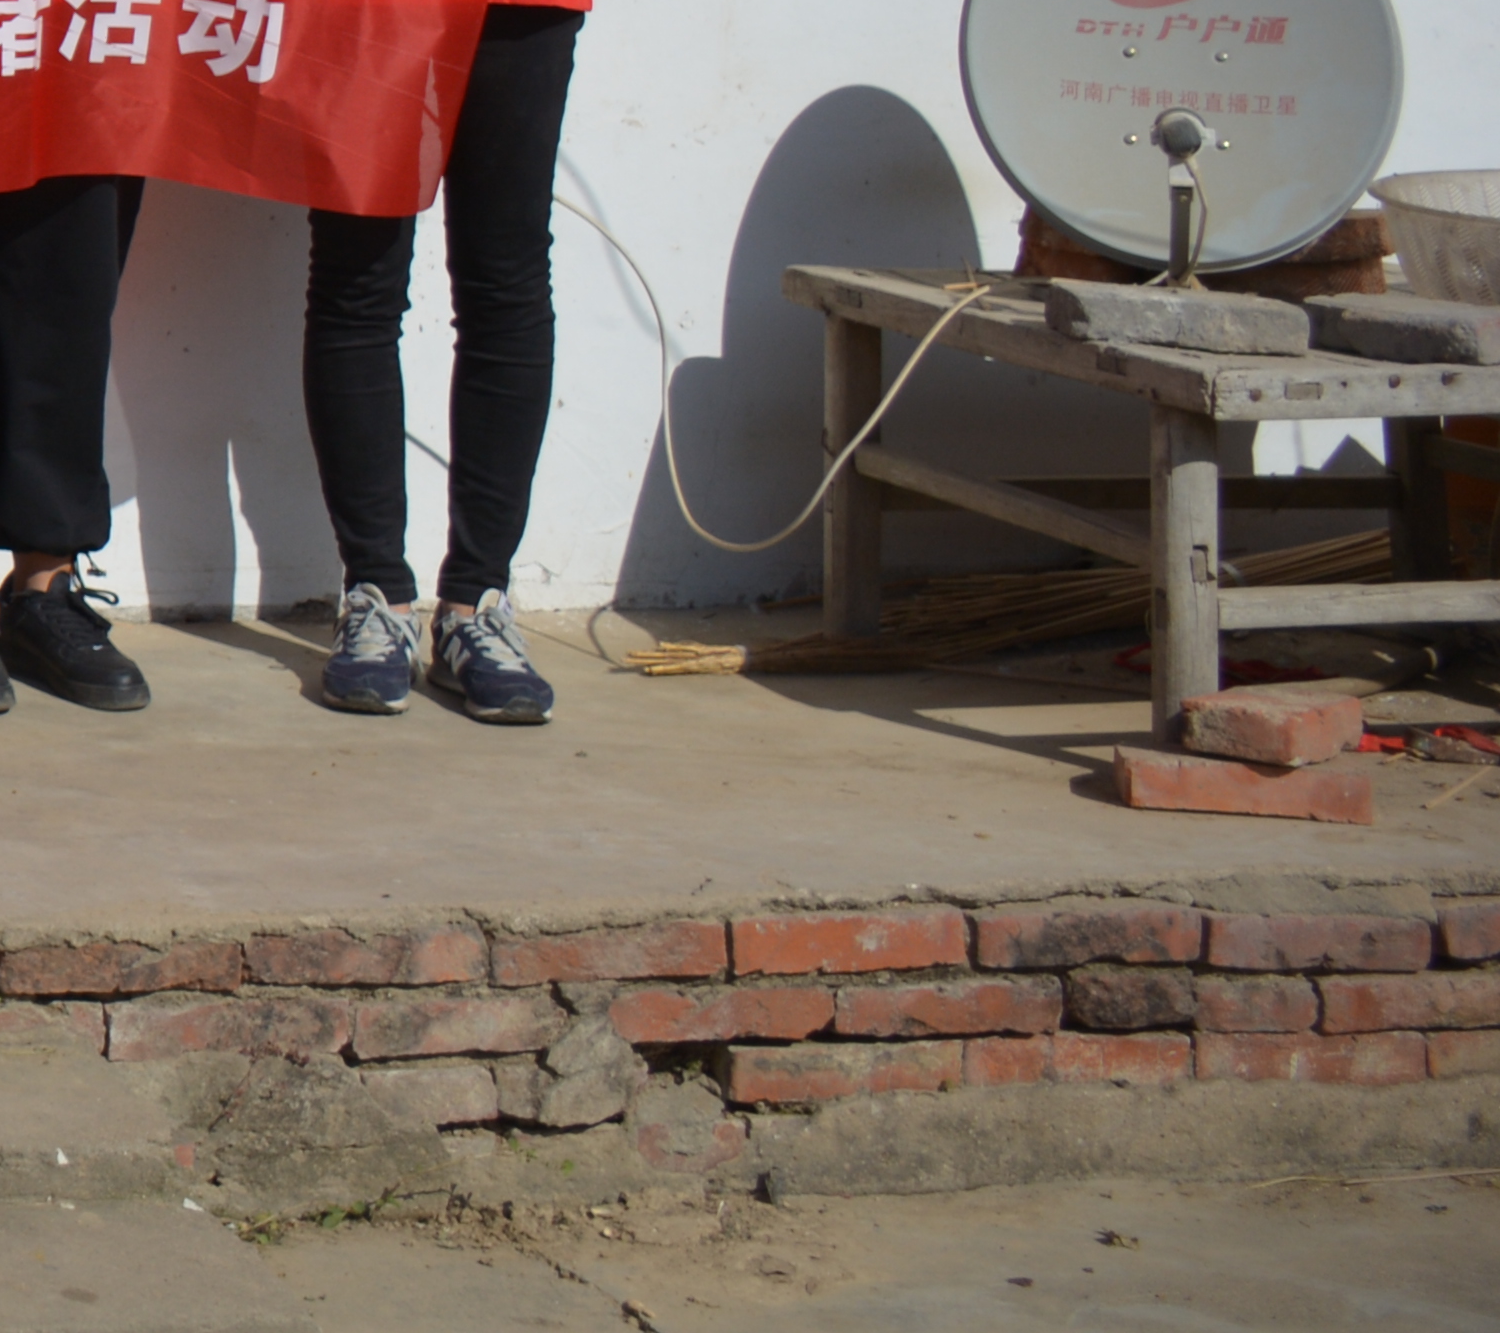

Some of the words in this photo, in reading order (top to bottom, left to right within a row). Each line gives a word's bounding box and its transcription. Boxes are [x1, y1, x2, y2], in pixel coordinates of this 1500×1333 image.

[1074, 18, 1146, 38] DTH
[1156, 13, 1290, 45] 户户通
[1059, 77, 1299, 117] 河南广播电视直播卫星
